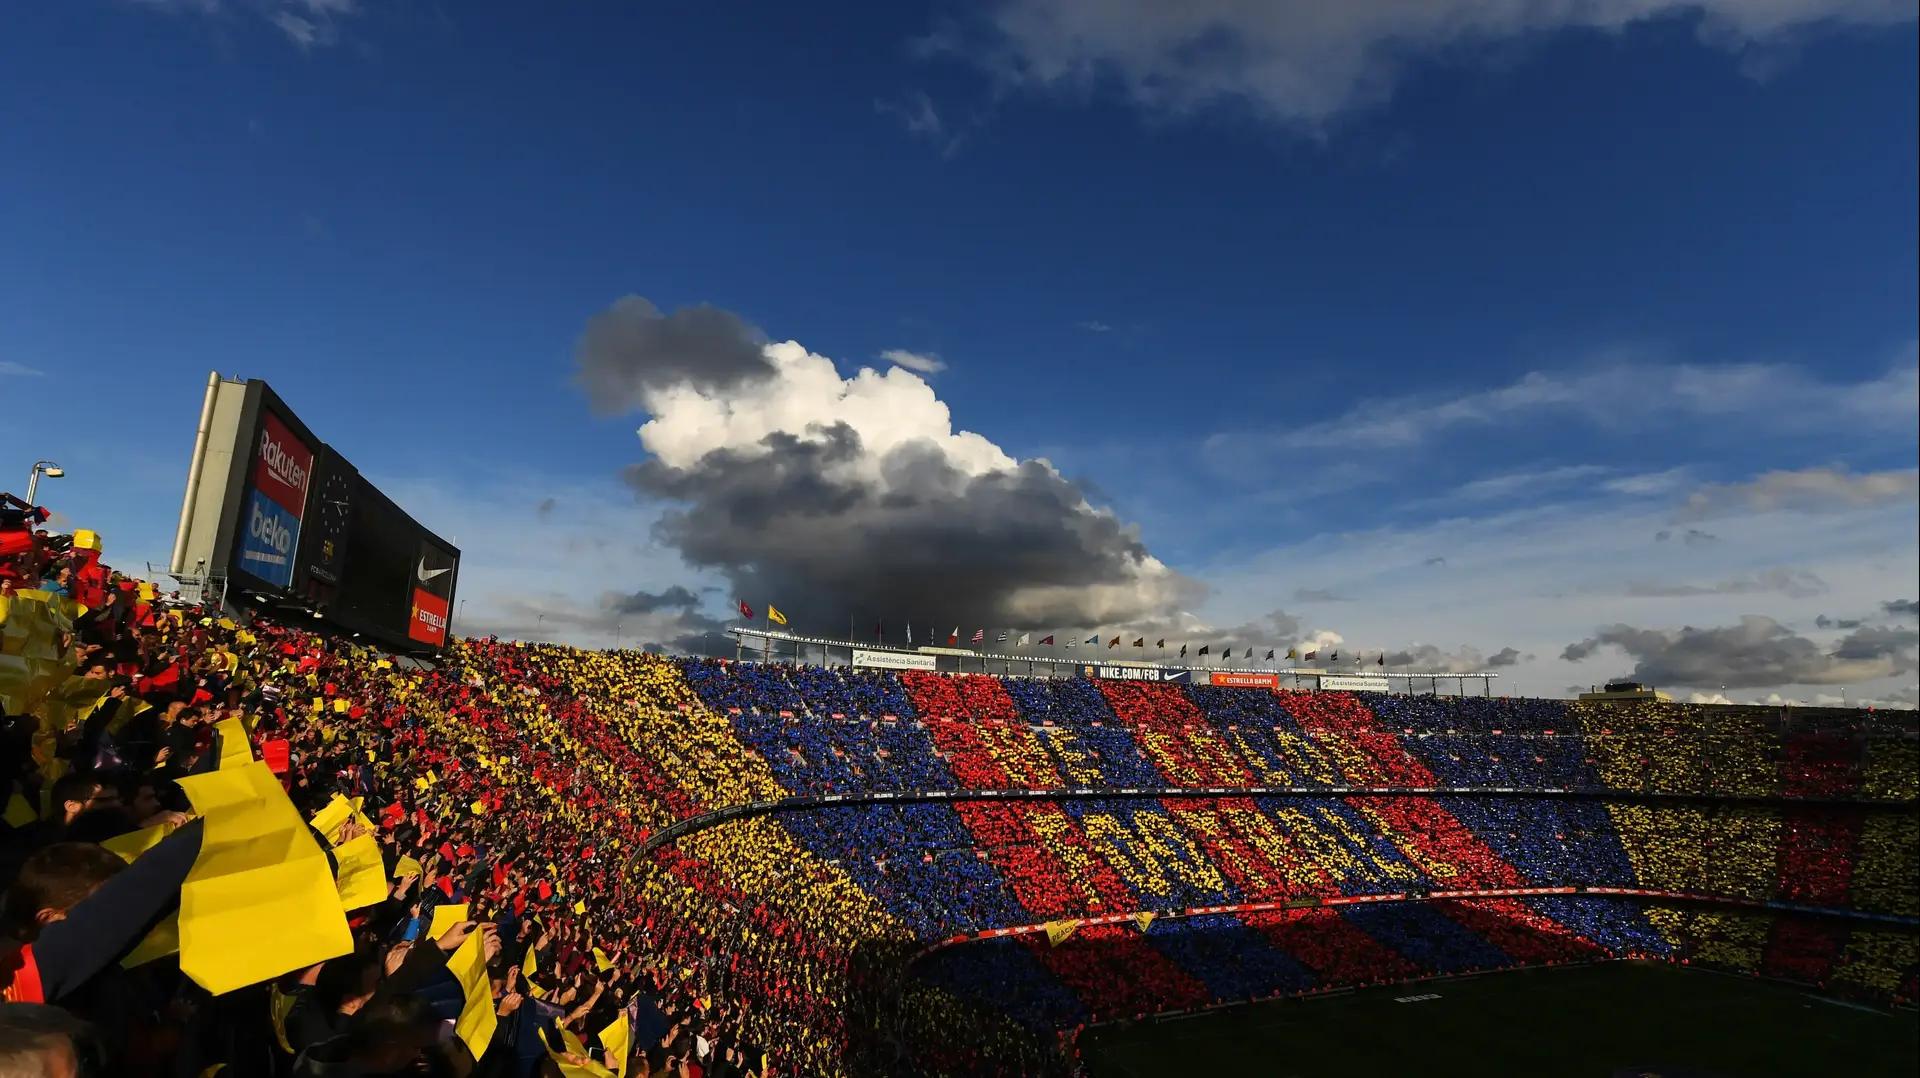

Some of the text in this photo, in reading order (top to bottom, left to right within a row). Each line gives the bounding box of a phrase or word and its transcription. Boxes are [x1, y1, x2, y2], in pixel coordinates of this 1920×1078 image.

[258, 428, 306, 492] Rakuten
[250, 502, 292, 555] beko
[1100, 666, 1160, 681] NIKE.COM/FCB
